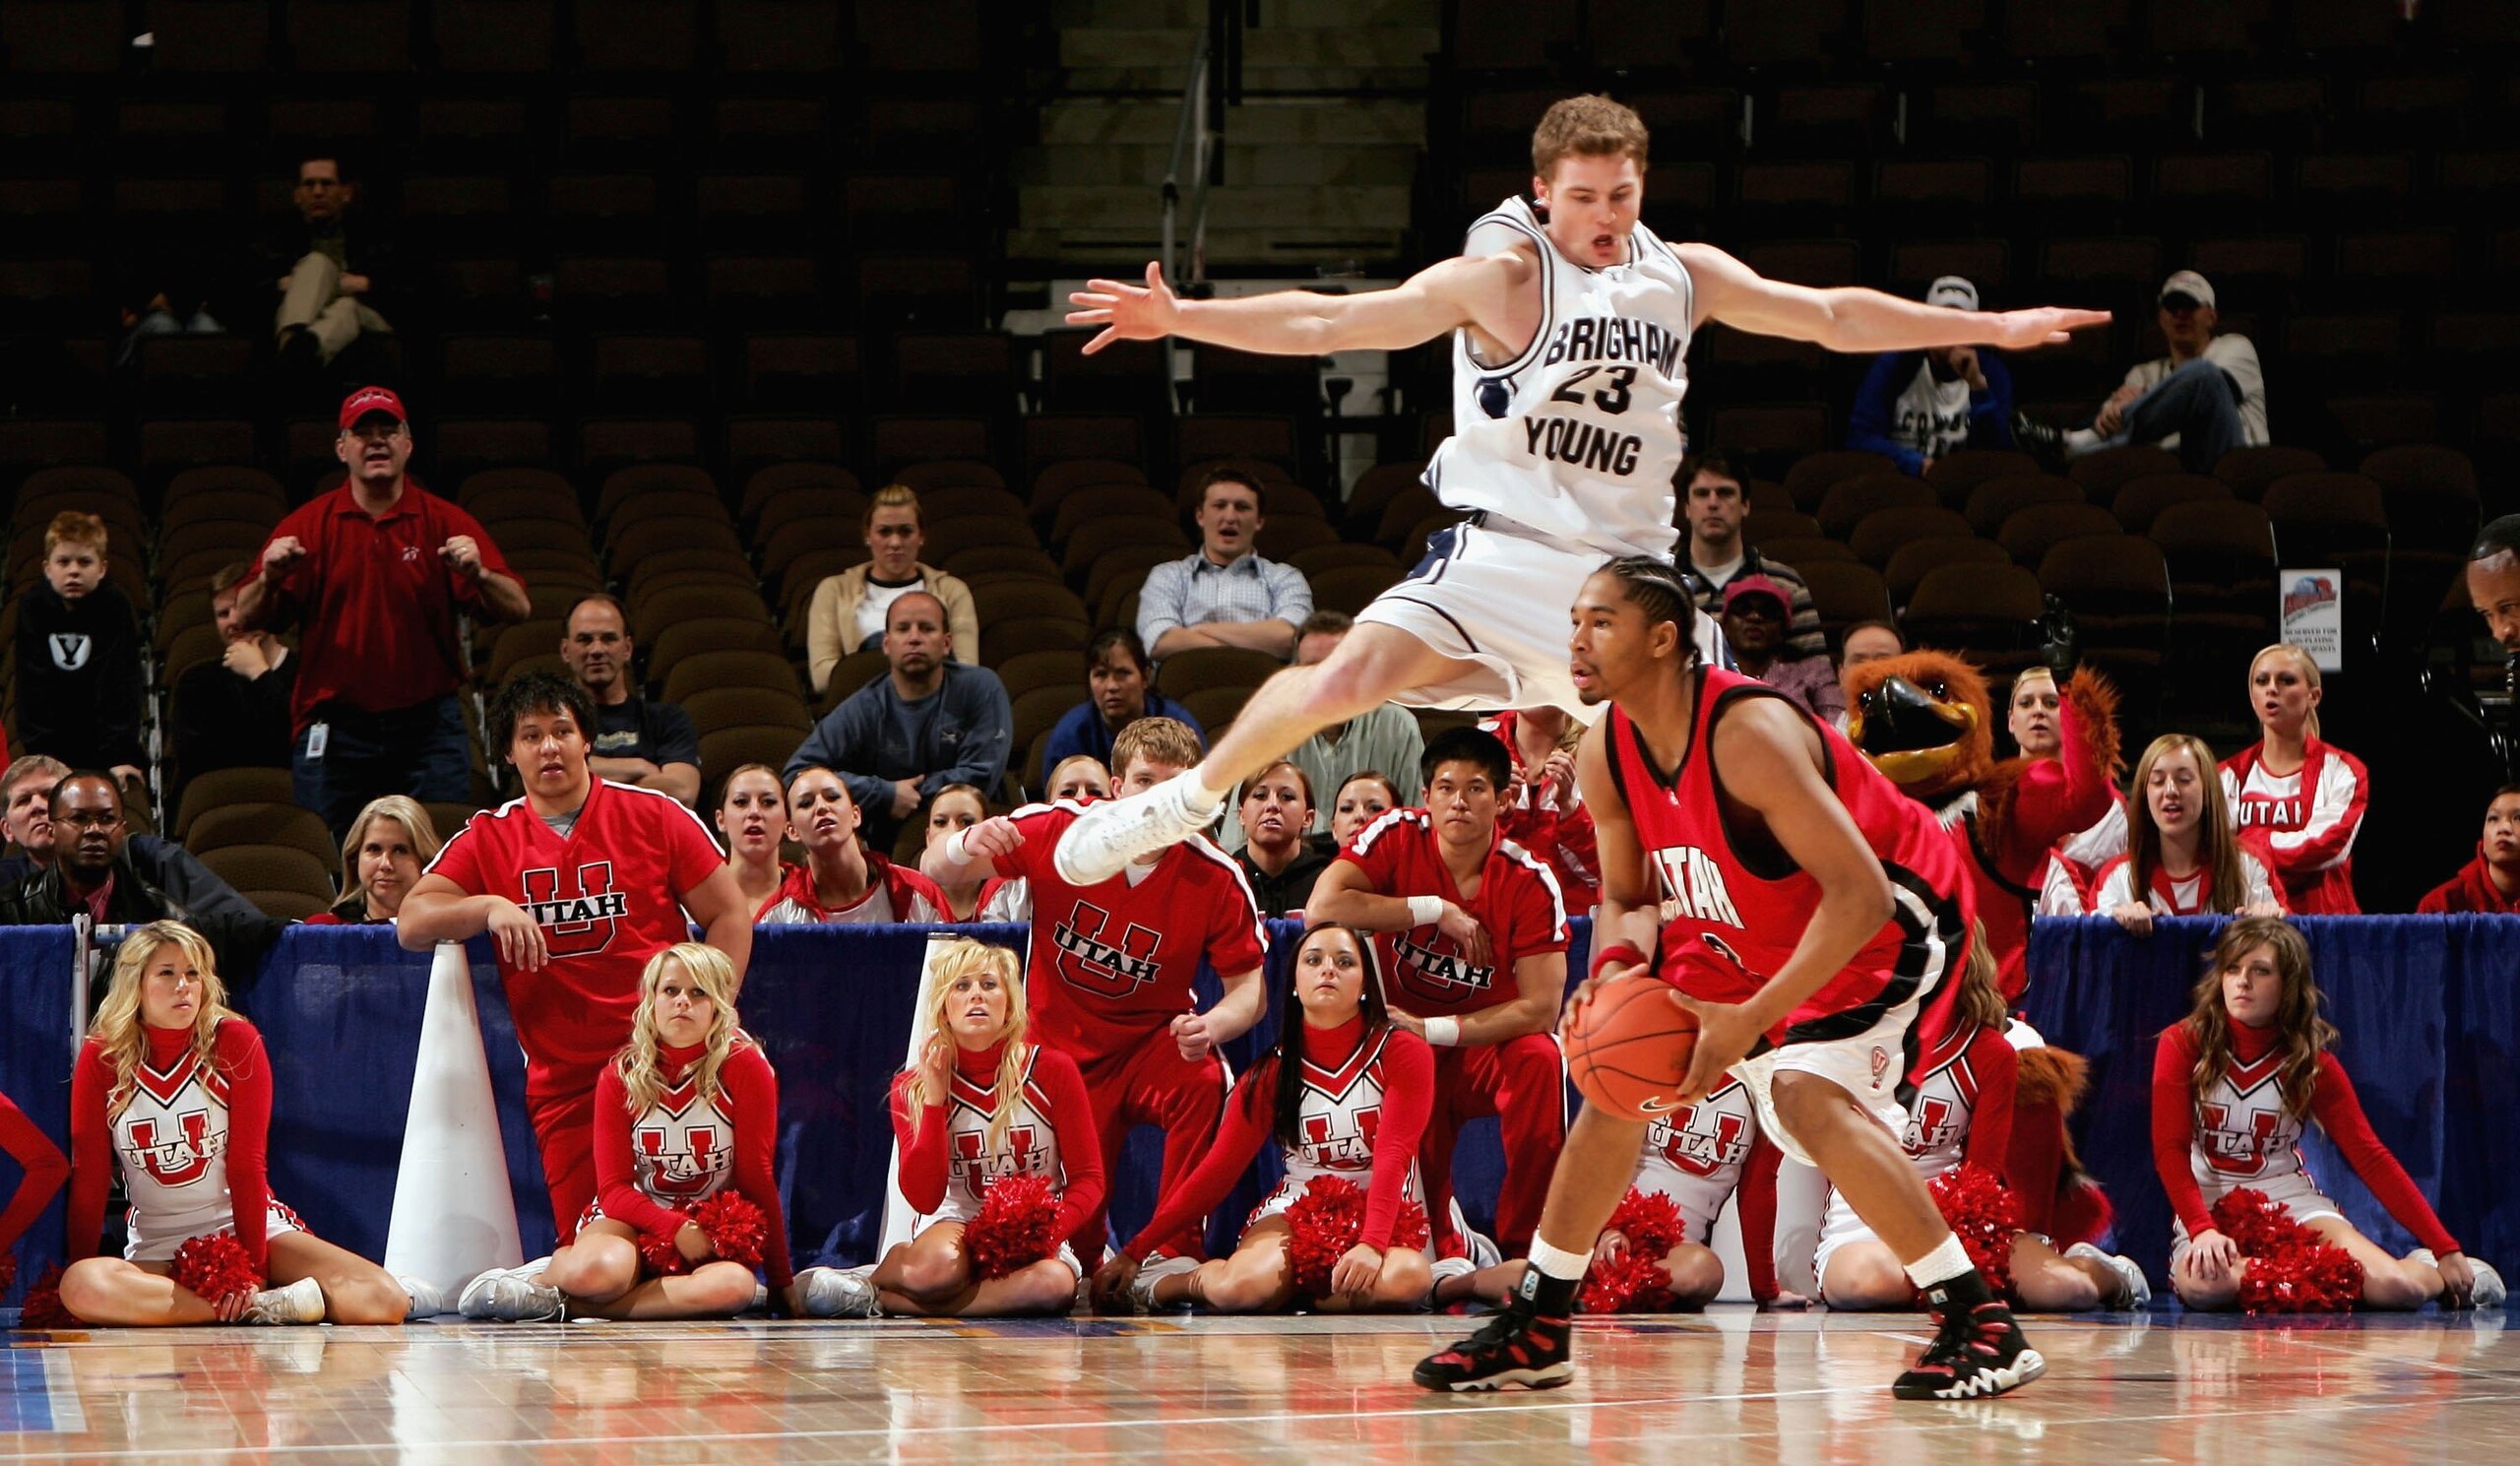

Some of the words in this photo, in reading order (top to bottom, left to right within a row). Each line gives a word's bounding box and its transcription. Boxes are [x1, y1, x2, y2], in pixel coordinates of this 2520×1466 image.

[1544, 316, 1681, 381] BRIGHAM
[1550, 365, 1639, 414] 23
[1525, 415, 1643, 477] YOUNG
[56, 634, 86, 666] Y
[1052, 921, 1162, 983] UTAH
[1392, 934, 1495, 989] UTAH
[121, 1129, 227, 1170] UTAH
[1299, 1136, 1374, 1166] UTA
[1647, 1120, 1748, 1165] UTAH
[1902, 1120, 1959, 1148] AH
[635, 1145, 733, 1177] UTAH
[949, 1146, 1049, 1179] UTAH
